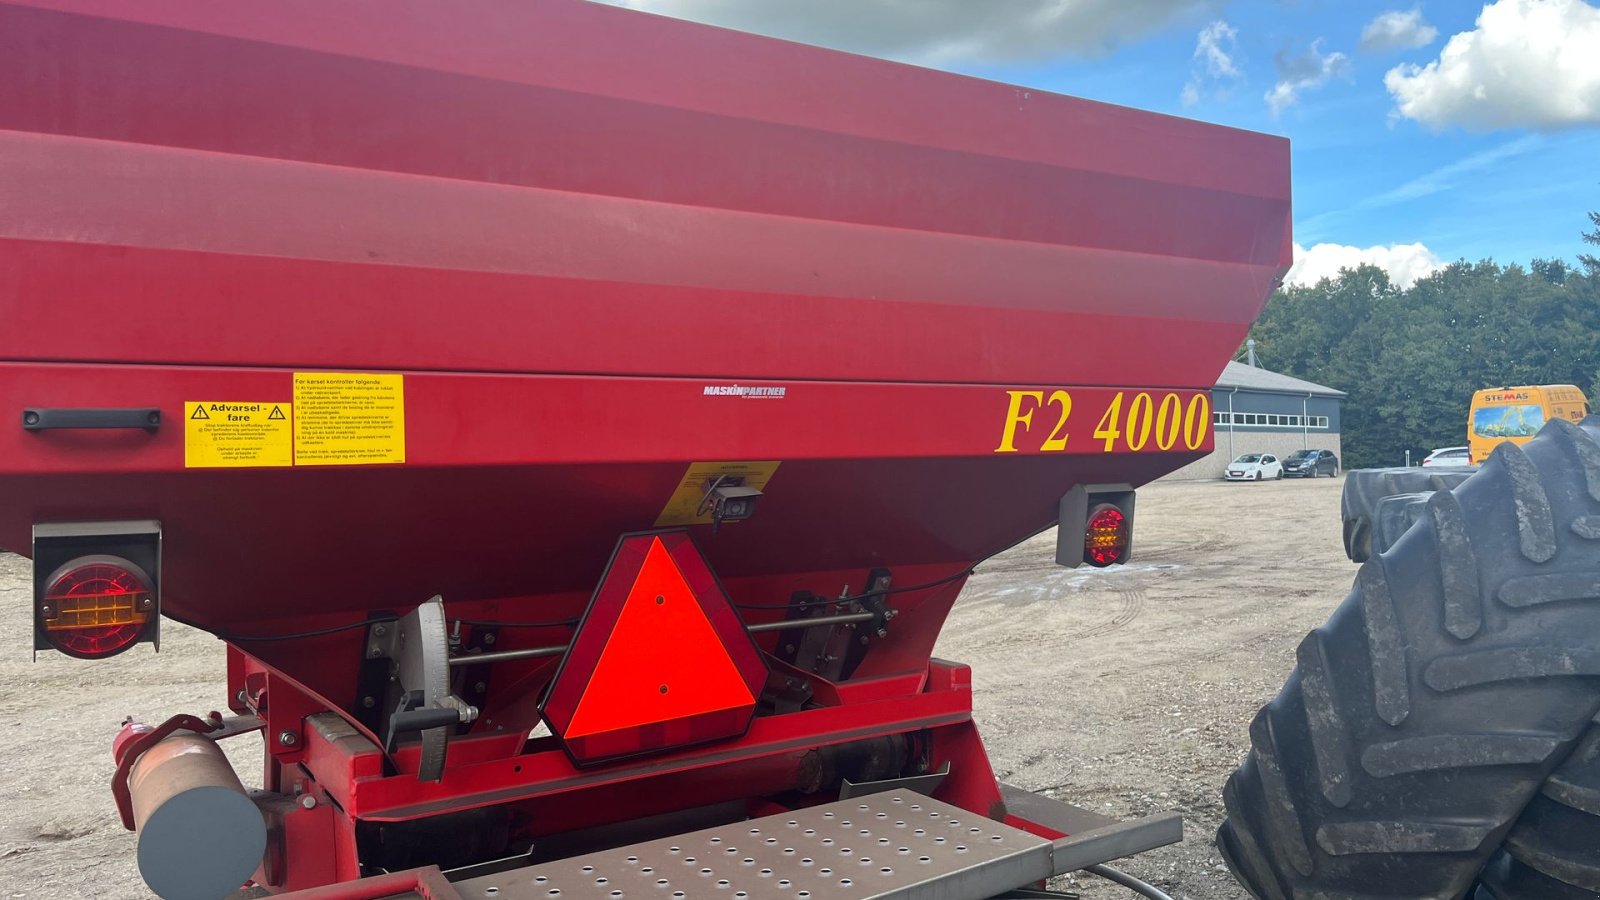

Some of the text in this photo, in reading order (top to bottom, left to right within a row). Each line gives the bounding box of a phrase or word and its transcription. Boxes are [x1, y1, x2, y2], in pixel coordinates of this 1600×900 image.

[1485, 393, 1529, 402] STEMAS
[210, 404, 260, 412] Advarsel
[994, 390, 1209, 452] F2 4000
